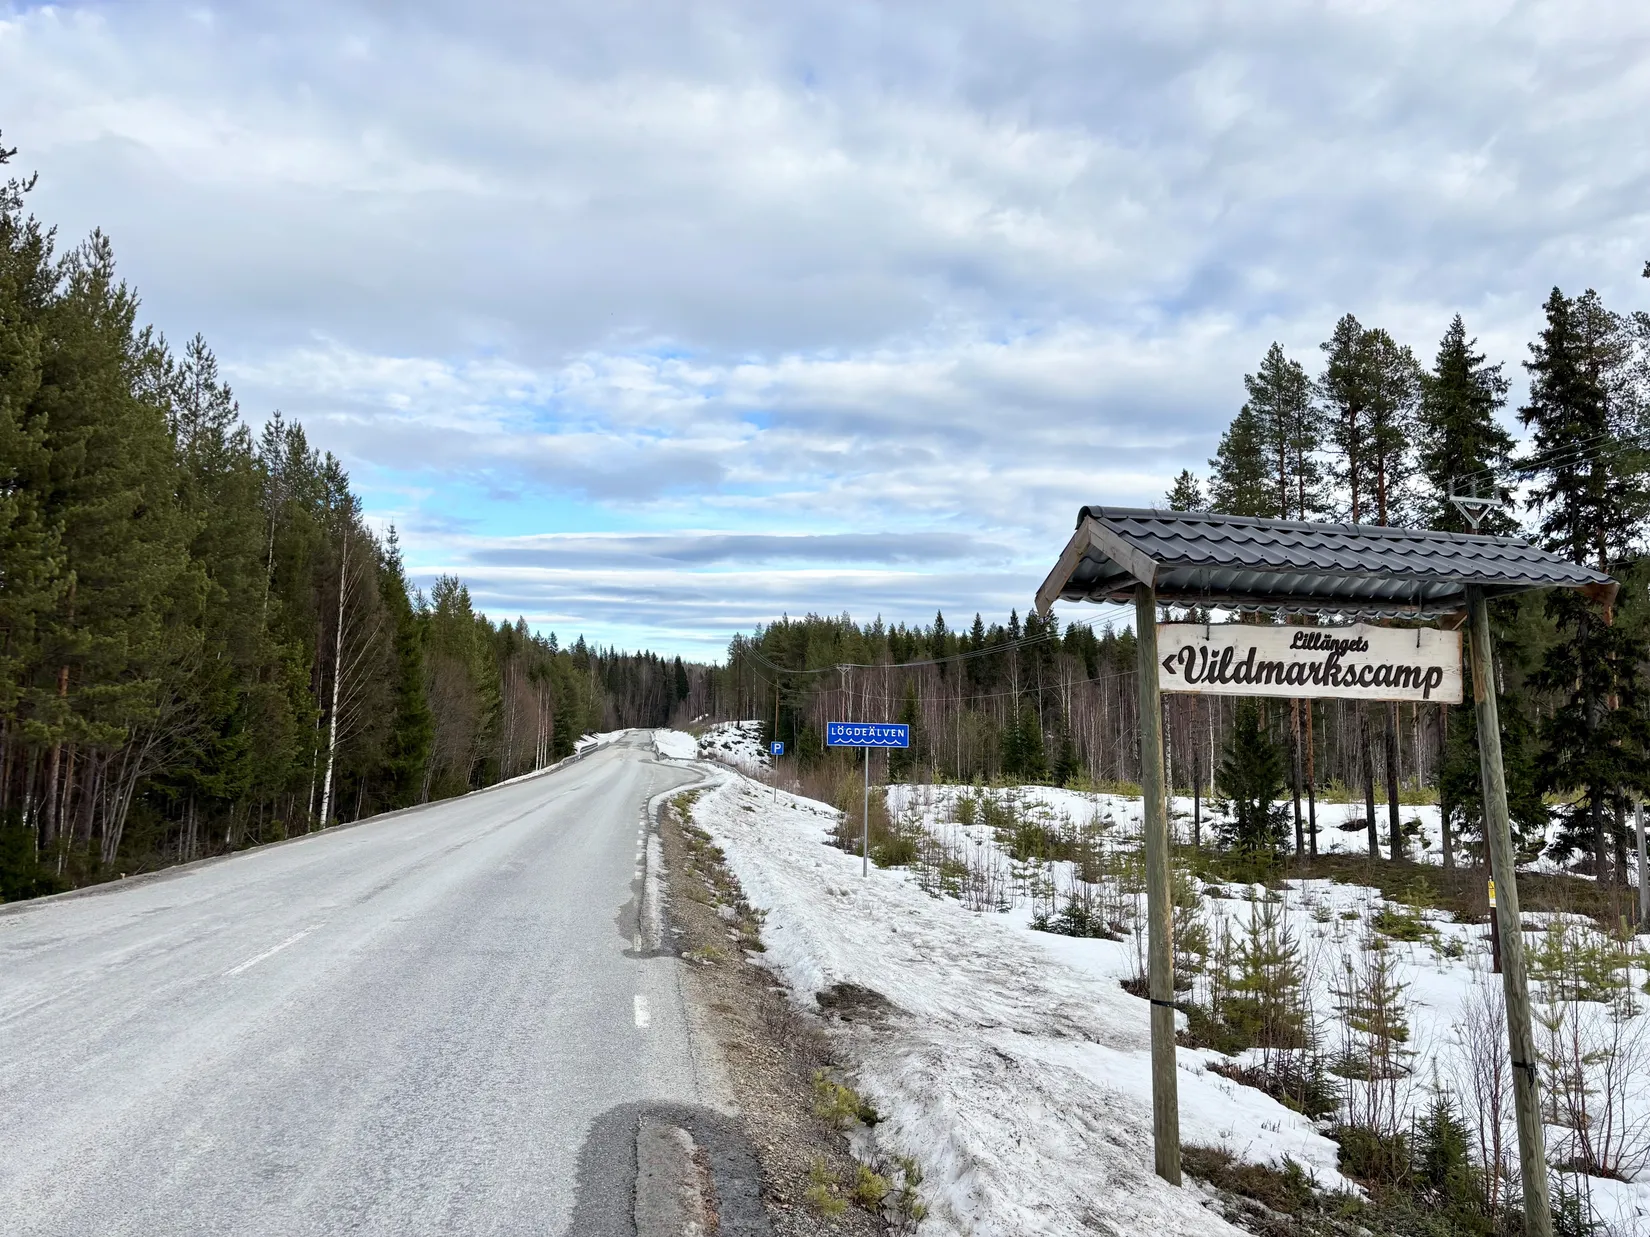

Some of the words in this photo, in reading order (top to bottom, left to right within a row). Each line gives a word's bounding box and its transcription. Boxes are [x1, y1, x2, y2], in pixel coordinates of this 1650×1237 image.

[1289, 631, 1369, 655] Lillängets
[1177, 645, 1444, 699] Vildmarkscamp
[831, 726, 905, 737] LÖGDEÄLVEN
[774, 744, 781, 753] P
